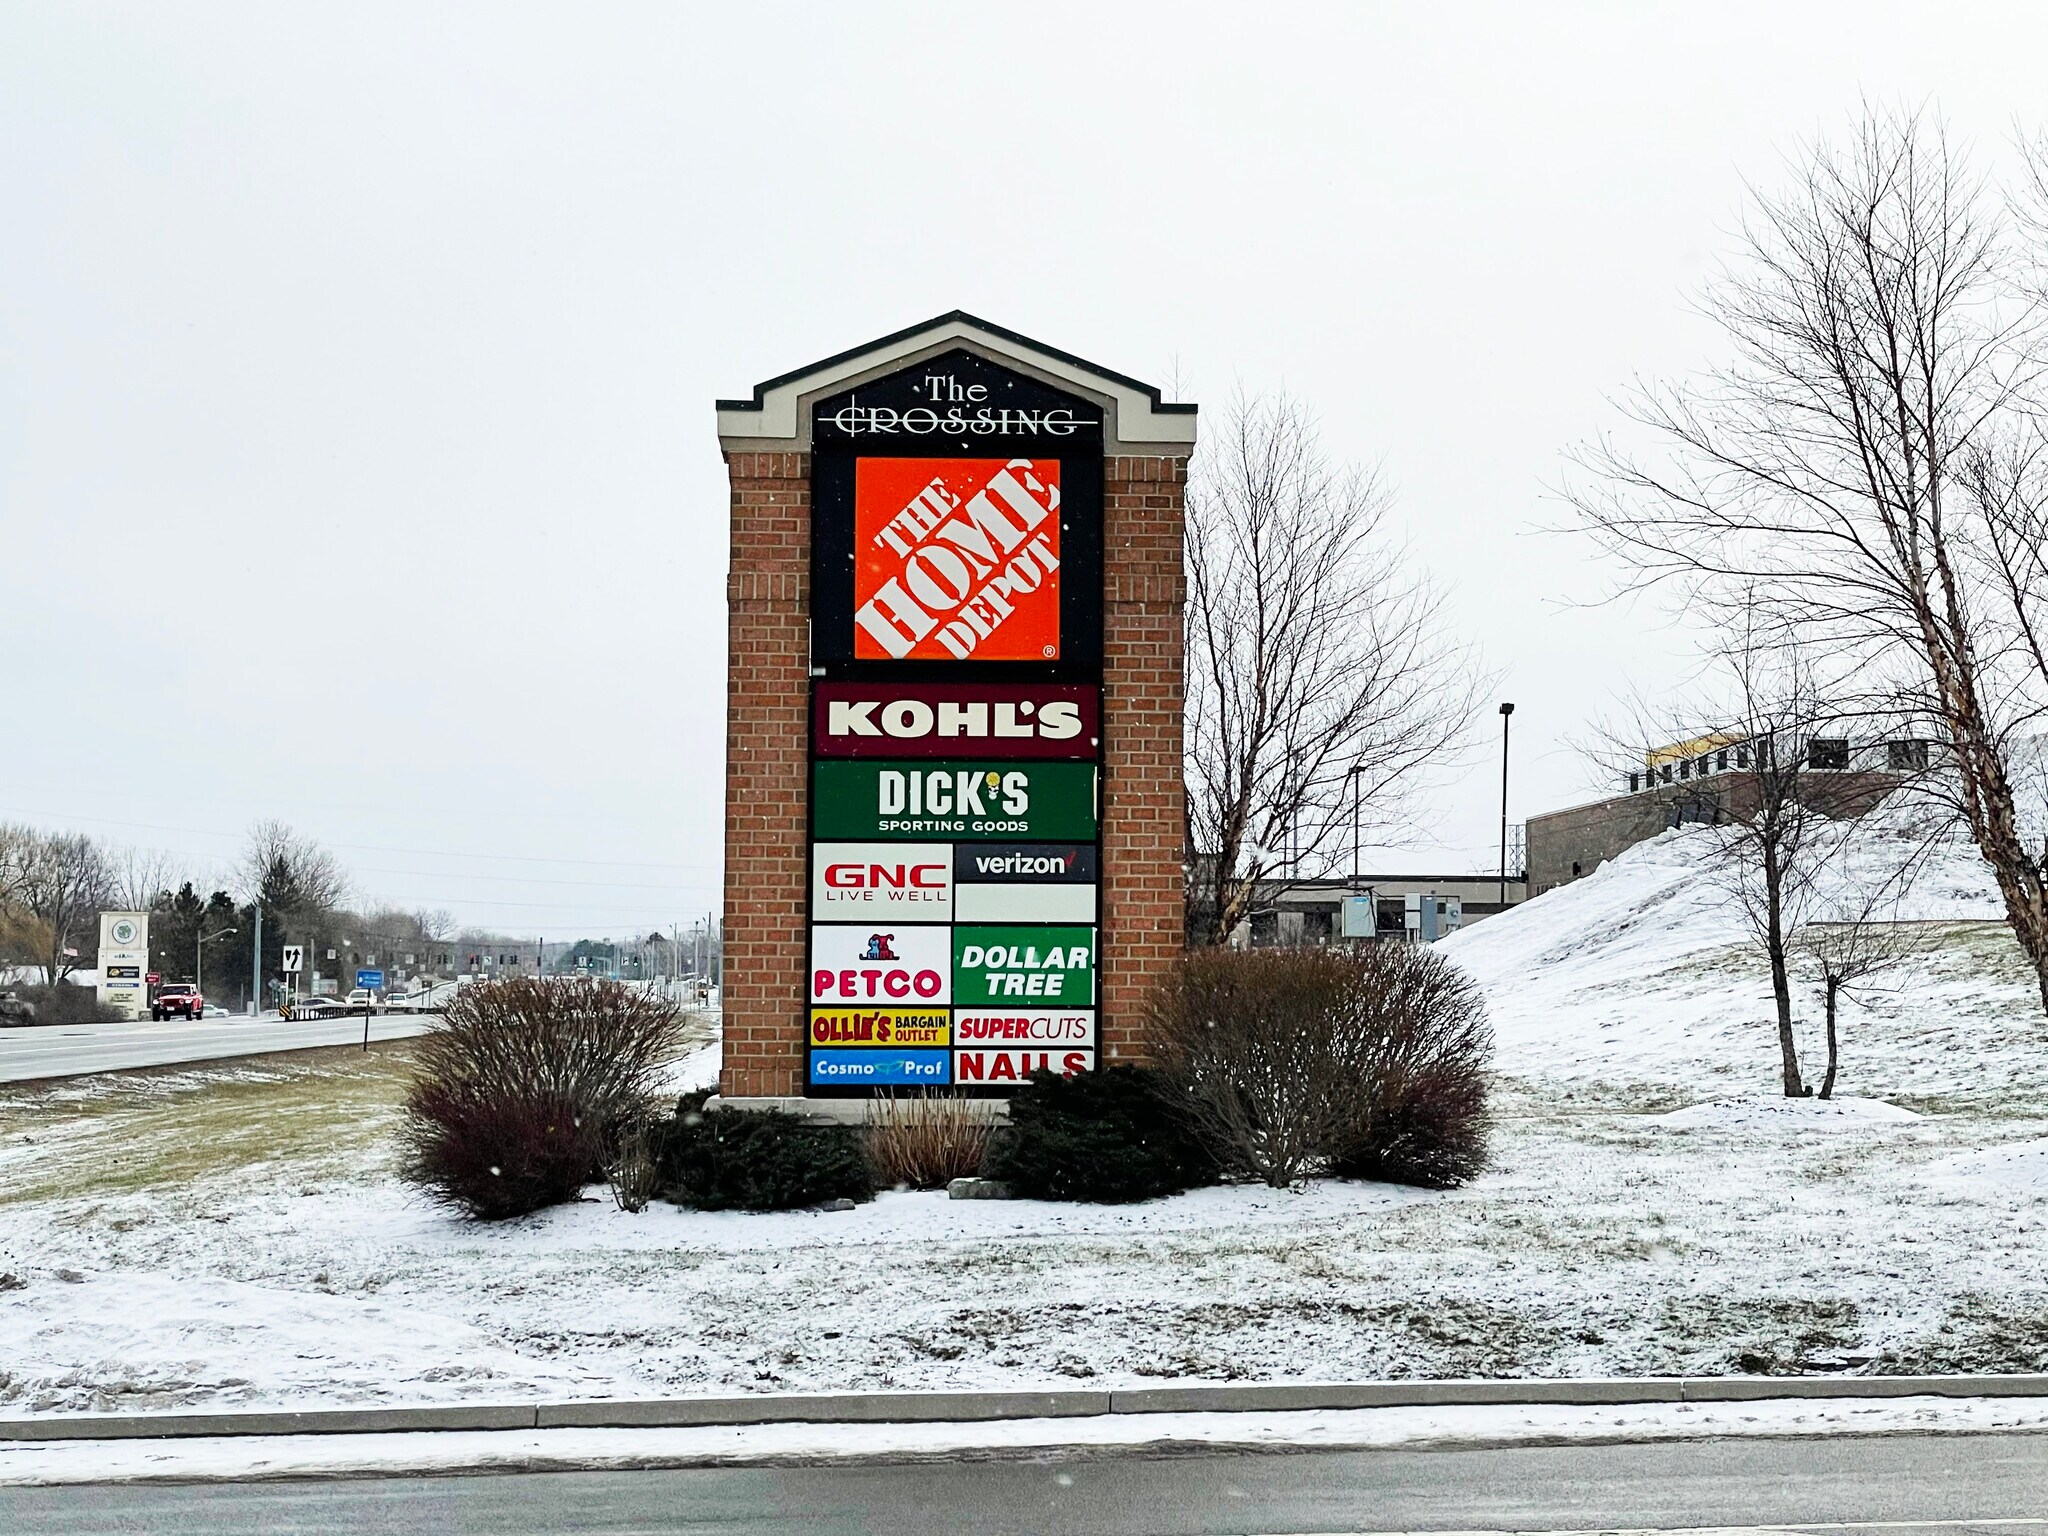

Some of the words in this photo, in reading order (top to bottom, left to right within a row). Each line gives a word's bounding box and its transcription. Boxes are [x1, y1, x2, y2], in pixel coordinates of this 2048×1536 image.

[925, 375, 988, 401] The
[835, 406, 1078, 436] CROSSING
[873, 476, 961, 559] THE
[855, 458, 1060, 659] HOME
[934, 532, 1060, 660] DEPOT
[829, 700, 1083, 739] KOHL'S
[879, 770, 1029, 816] DICK'S
[878, 820, 965, 832] SPORTING
[972, 821, 1029, 832] GOODS
[975, 852, 1066, 874] verizon
[824, 864, 947, 888] GNC
[826, 890, 874, 901] LIVE
[888, 890, 947, 901] WELL
[960, 945, 1090, 969] DOLLAR
[814, 969, 942, 998] PETCO
[985, 973, 1065, 996] TREE
[895, 1015, 947, 1029] BARGAIN
[958, 1017, 1087, 1039] SUPERCUTS
[895, 1029, 939, 1042] OUTLET
[816, 1060, 875, 1076] Cosmo
[904, 1060, 942, 1076] Prof
